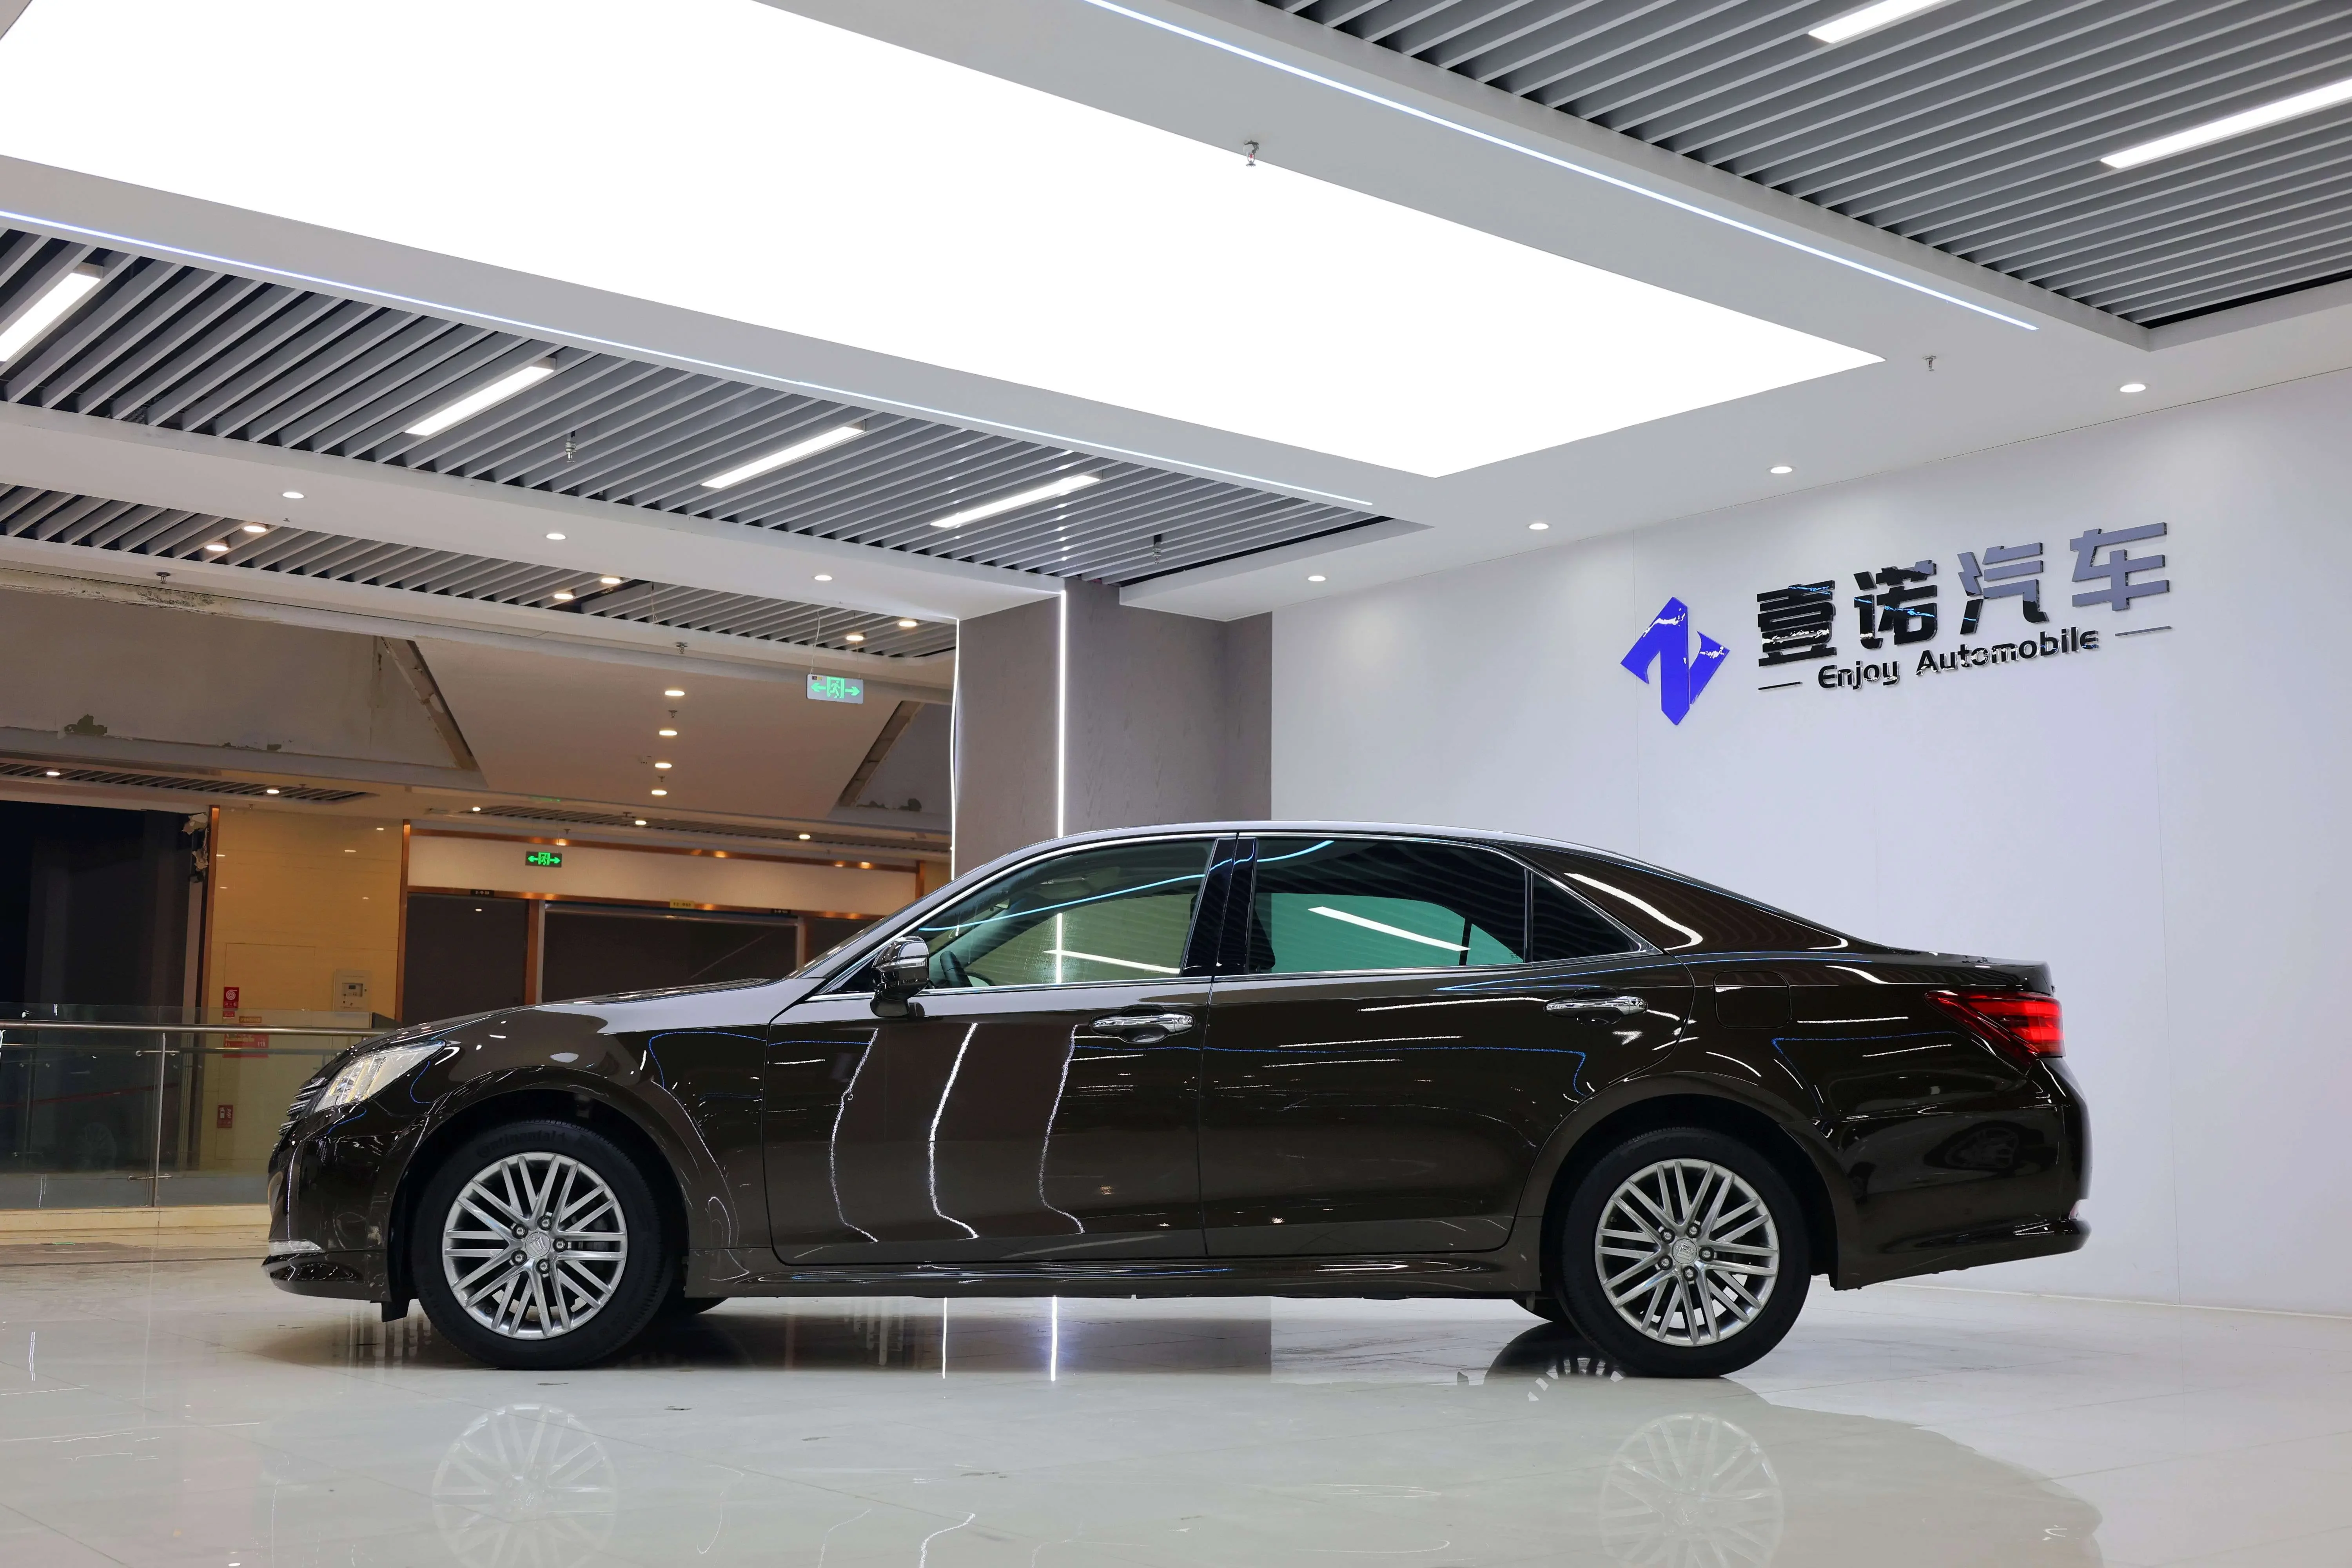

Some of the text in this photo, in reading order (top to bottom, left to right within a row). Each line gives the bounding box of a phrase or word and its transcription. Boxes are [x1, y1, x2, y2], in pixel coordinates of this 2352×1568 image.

[1757, 522, 2169, 666] 壹诺汽车
[1818, 626, 2099, 690] Enjoy Automobile
